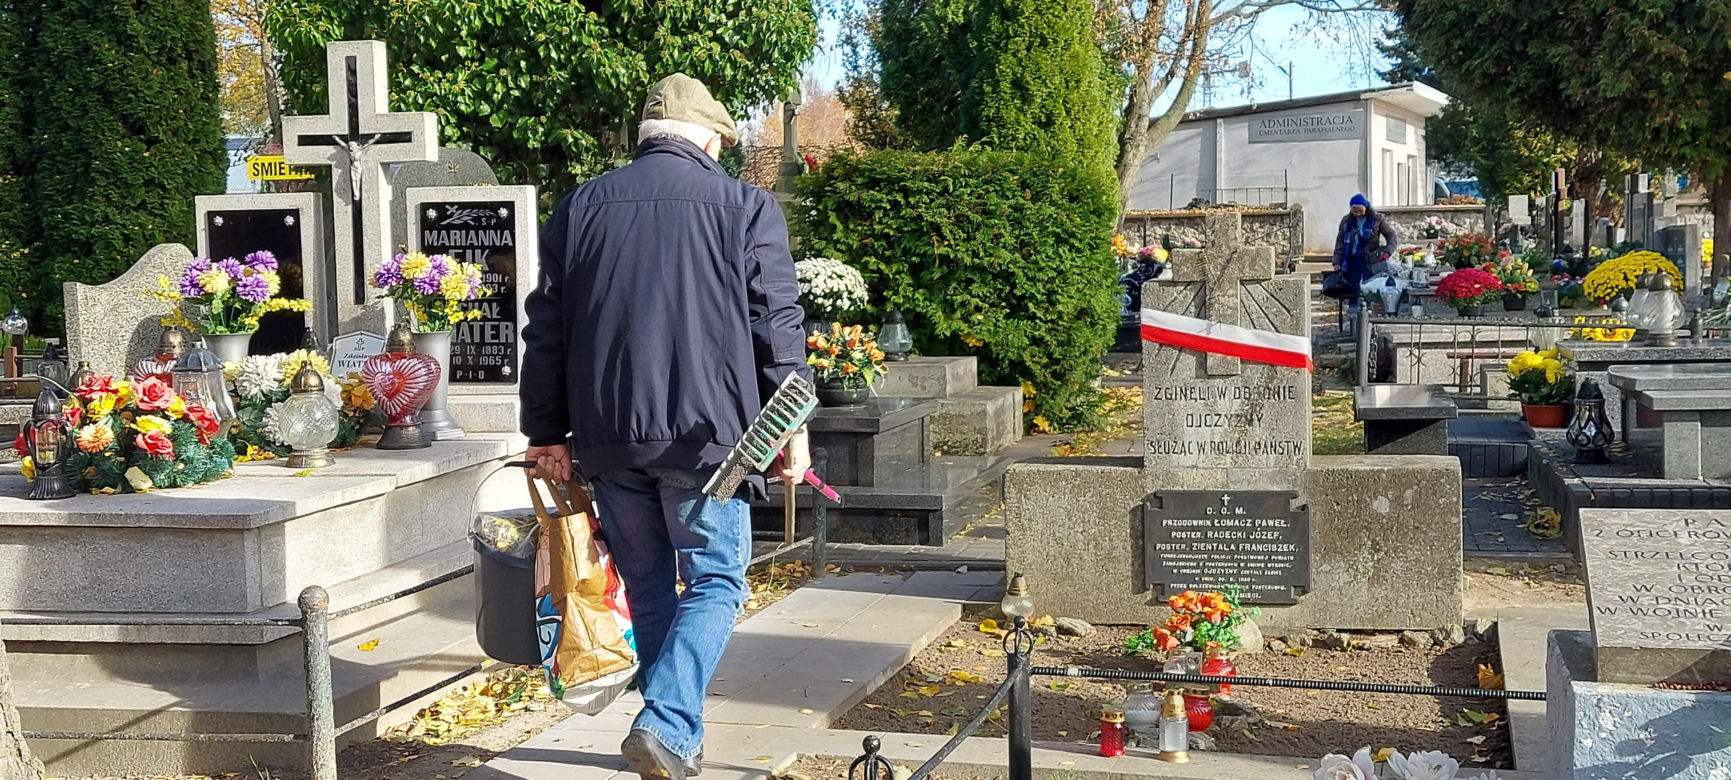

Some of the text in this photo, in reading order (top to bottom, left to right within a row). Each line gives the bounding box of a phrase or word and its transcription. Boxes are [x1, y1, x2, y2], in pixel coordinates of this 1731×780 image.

[1260, 115, 1353, 129] ADMINISTRACJA
[1258, 125, 1356, 137] CMENTARZA PARAFIALNEGO
[252, 157, 315, 177] ŚMIET
[424, 229, 513, 246] MARIANNA
[457, 302, 502, 319] CHAŁ
[450, 321, 514, 343] IATER
[482, 345, 505, 355] 1883
[337, 360, 364, 368] WIAT
[479, 356, 502, 366] 1965
[1153, 386, 1210, 402] ZGINĘLI
[1217, 386, 1228, 401] W
[1185, 413, 1264, 428] OJCZYZNY
[1196, 440, 1207, 455] W
[1162, 519, 1211, 527] PRZODOWNIK
[1213, 519, 1252, 527] ŁOMACZ
[1171, 531, 1204, 539] POSTER.
[1207, 531, 1246, 539] RADECKI
[1156, 543, 1189, 551] POSTER.
[1192, 542, 1236, 551] ZIENTALA
[1632, 584, 1655, 593] W
[1618, 595, 1640, 604] W
[1597, 606, 1725, 619] W WOJNIE
